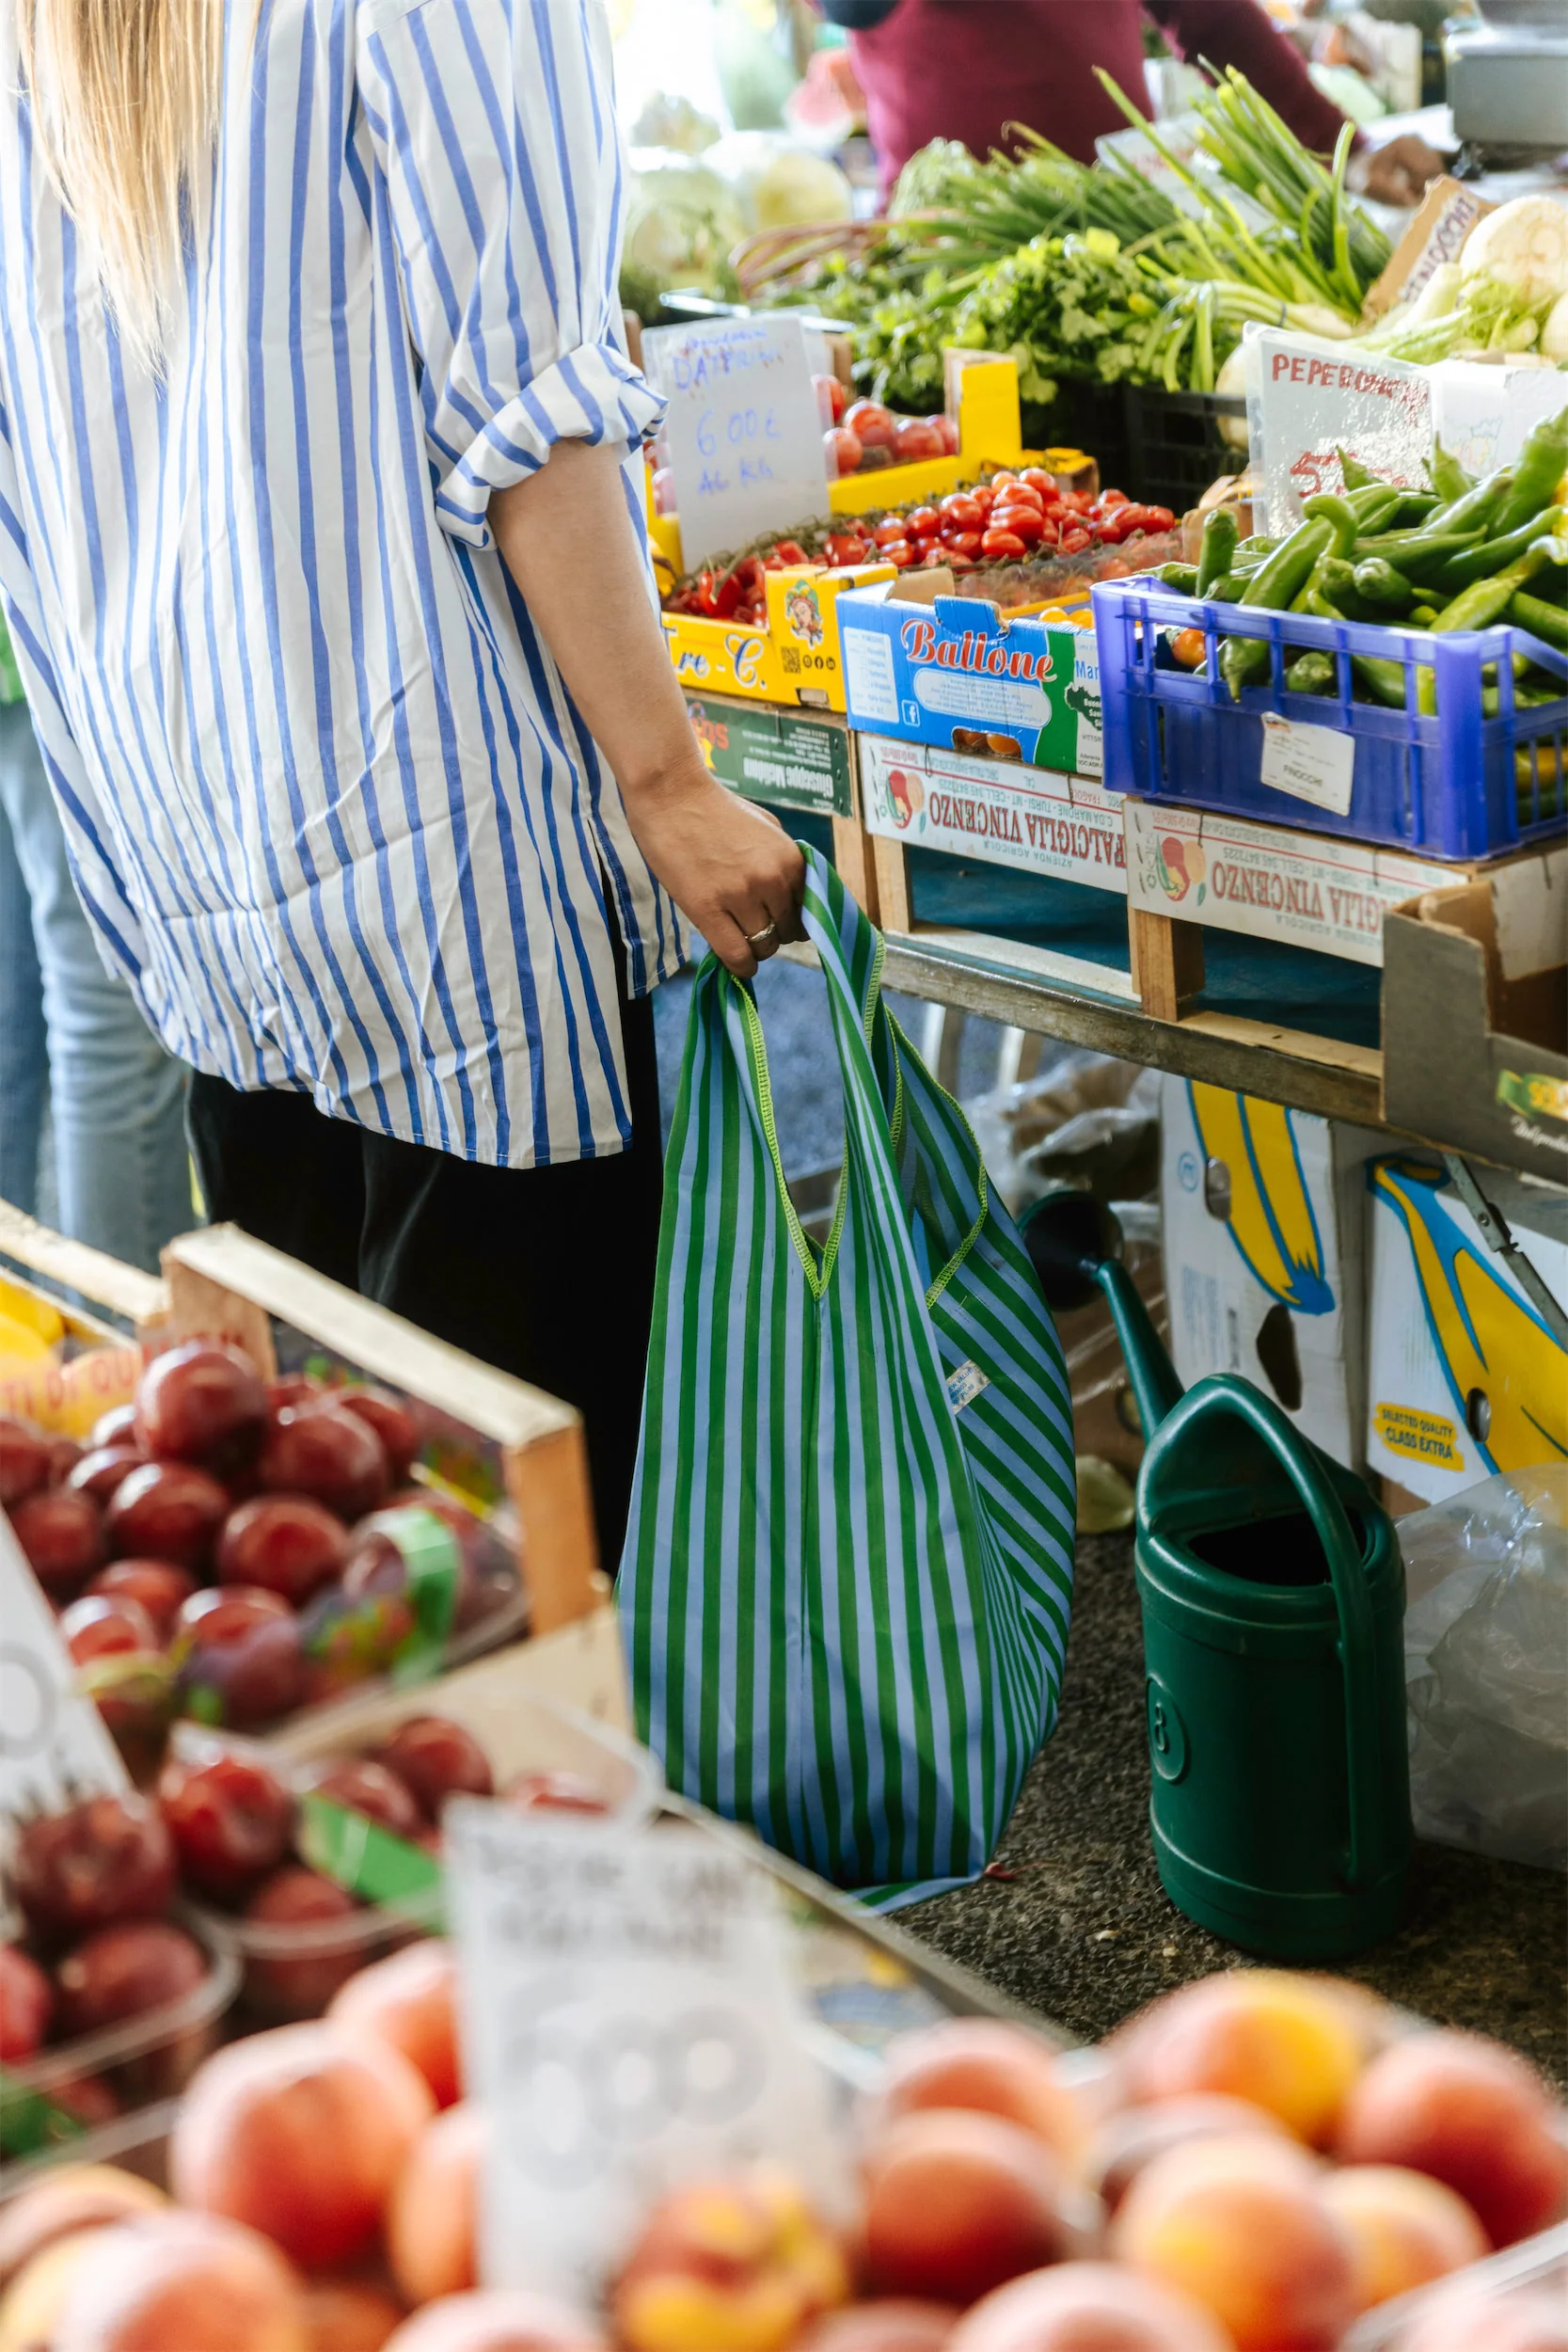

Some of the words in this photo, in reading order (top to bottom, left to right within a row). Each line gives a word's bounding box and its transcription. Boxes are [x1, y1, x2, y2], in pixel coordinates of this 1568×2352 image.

[901, 618, 1057, 682] Ballone
[929, 792, 1022, 844] VINCENZO
[983, 840, 1030, 858] AGRICOLA
[1024, 814, 1126, 869] FALCIGLIA
[1033, 852, 1073, 868] AZIENDA
[1212, 860, 1324, 918] VINCENZO
[1385, 1426, 1418, 1449] CLASS
[1418, 1436, 1453, 1459] EXTRA
[1419, 1420, 1453, 1438] QUALITY
